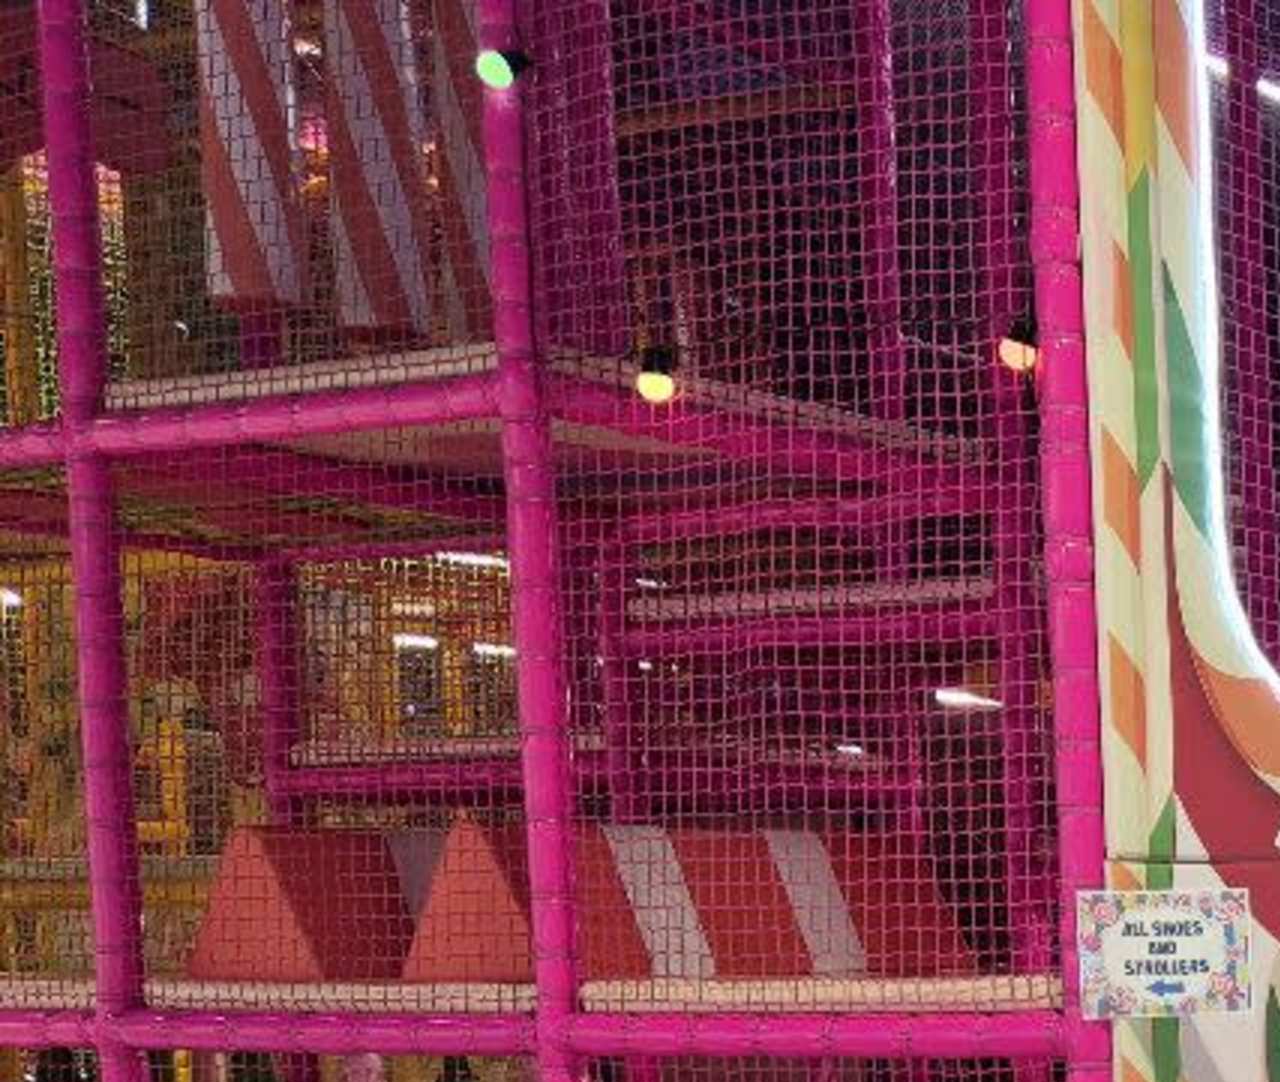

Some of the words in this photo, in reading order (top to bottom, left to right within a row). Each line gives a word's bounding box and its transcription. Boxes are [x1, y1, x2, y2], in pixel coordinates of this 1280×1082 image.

[1121, 921, 1150, 936] ALL
[1151, 920, 1204, 936] SHOES
[1148, 941, 1177, 954] AND
[1124, 959, 1210, 976] STROLLERS
